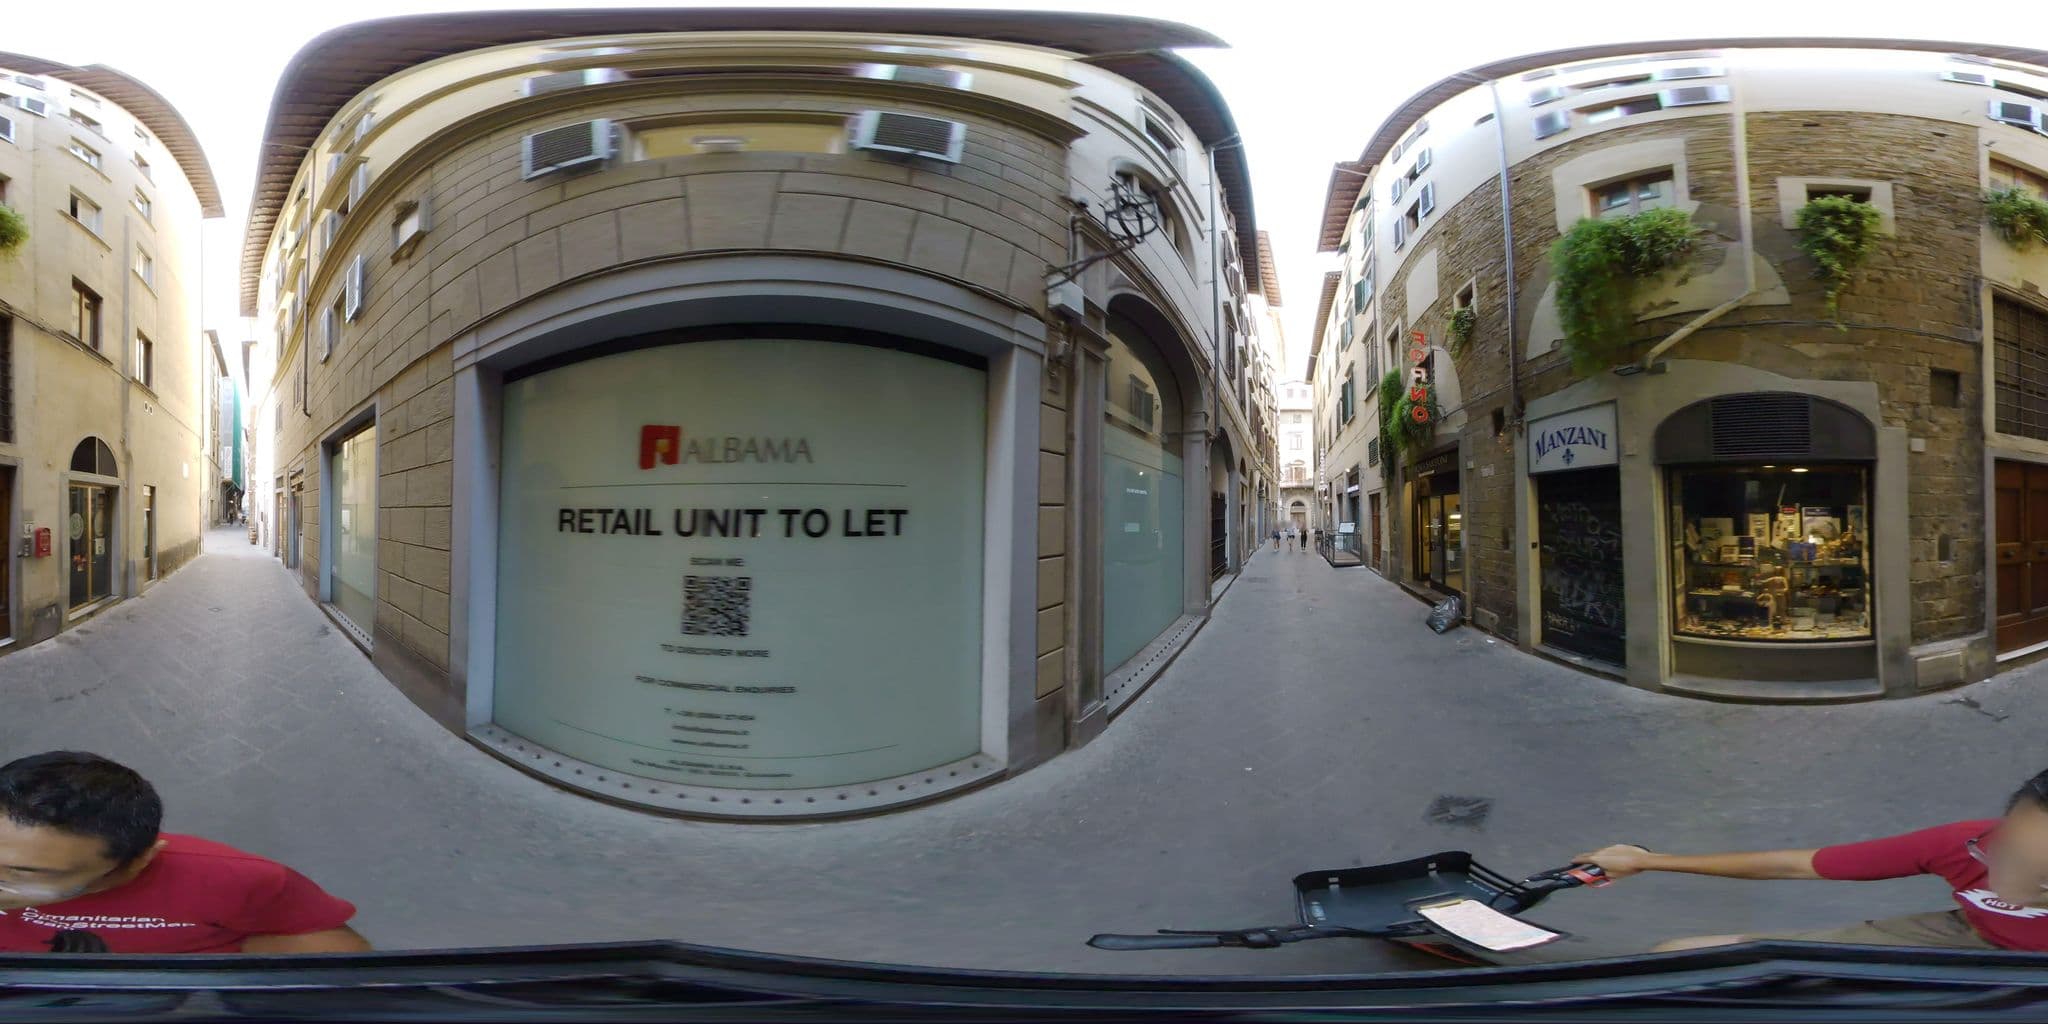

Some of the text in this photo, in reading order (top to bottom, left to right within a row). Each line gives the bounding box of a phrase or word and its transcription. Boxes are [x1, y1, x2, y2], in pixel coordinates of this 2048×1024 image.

[684, 436, 814, 464] ALBAMA
[1535, 426, 1608, 465] MANZANI
[558, 508, 909, 538] RETAIL UNIT TO LET
[1985, 899, 2017, 910] HOT
